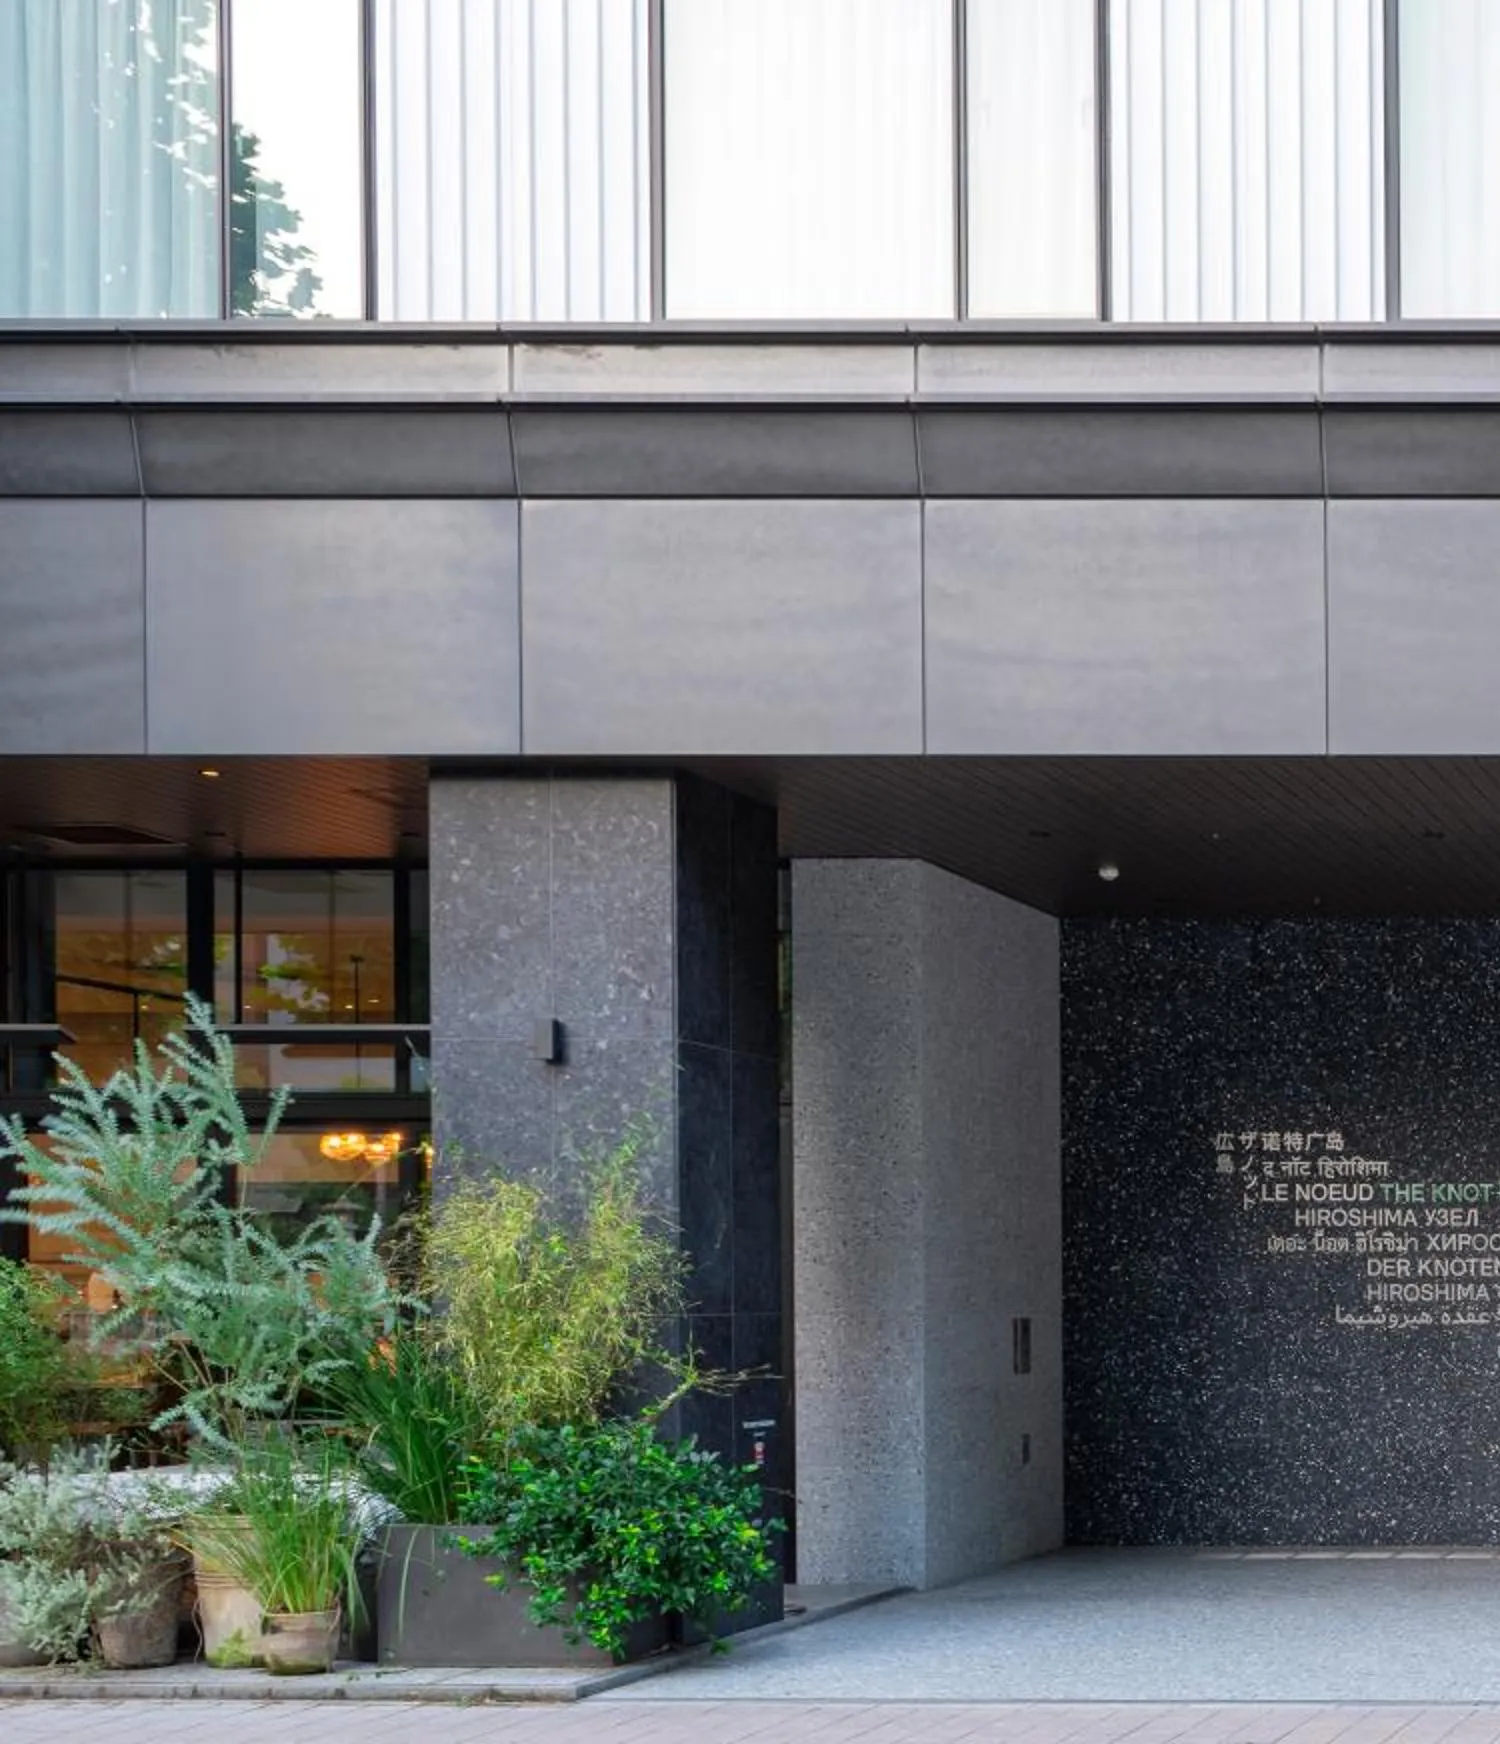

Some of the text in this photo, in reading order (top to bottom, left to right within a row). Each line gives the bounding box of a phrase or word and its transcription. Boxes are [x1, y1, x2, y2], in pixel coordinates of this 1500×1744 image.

[1261, 1183, 1289, 1201] LE
[1295, 1183, 1374, 1201] NOEUD
[1380, 1183, 1425, 1201] THE
[1431, 1183, 1494, 1201] KNOT
[1294, 1208, 1479, 1227] HIROSHIMA УЗЕЛ
[1367, 1259, 1411, 1277] DER
[1366, 1283, 1490, 1301] HIROSHIMA
